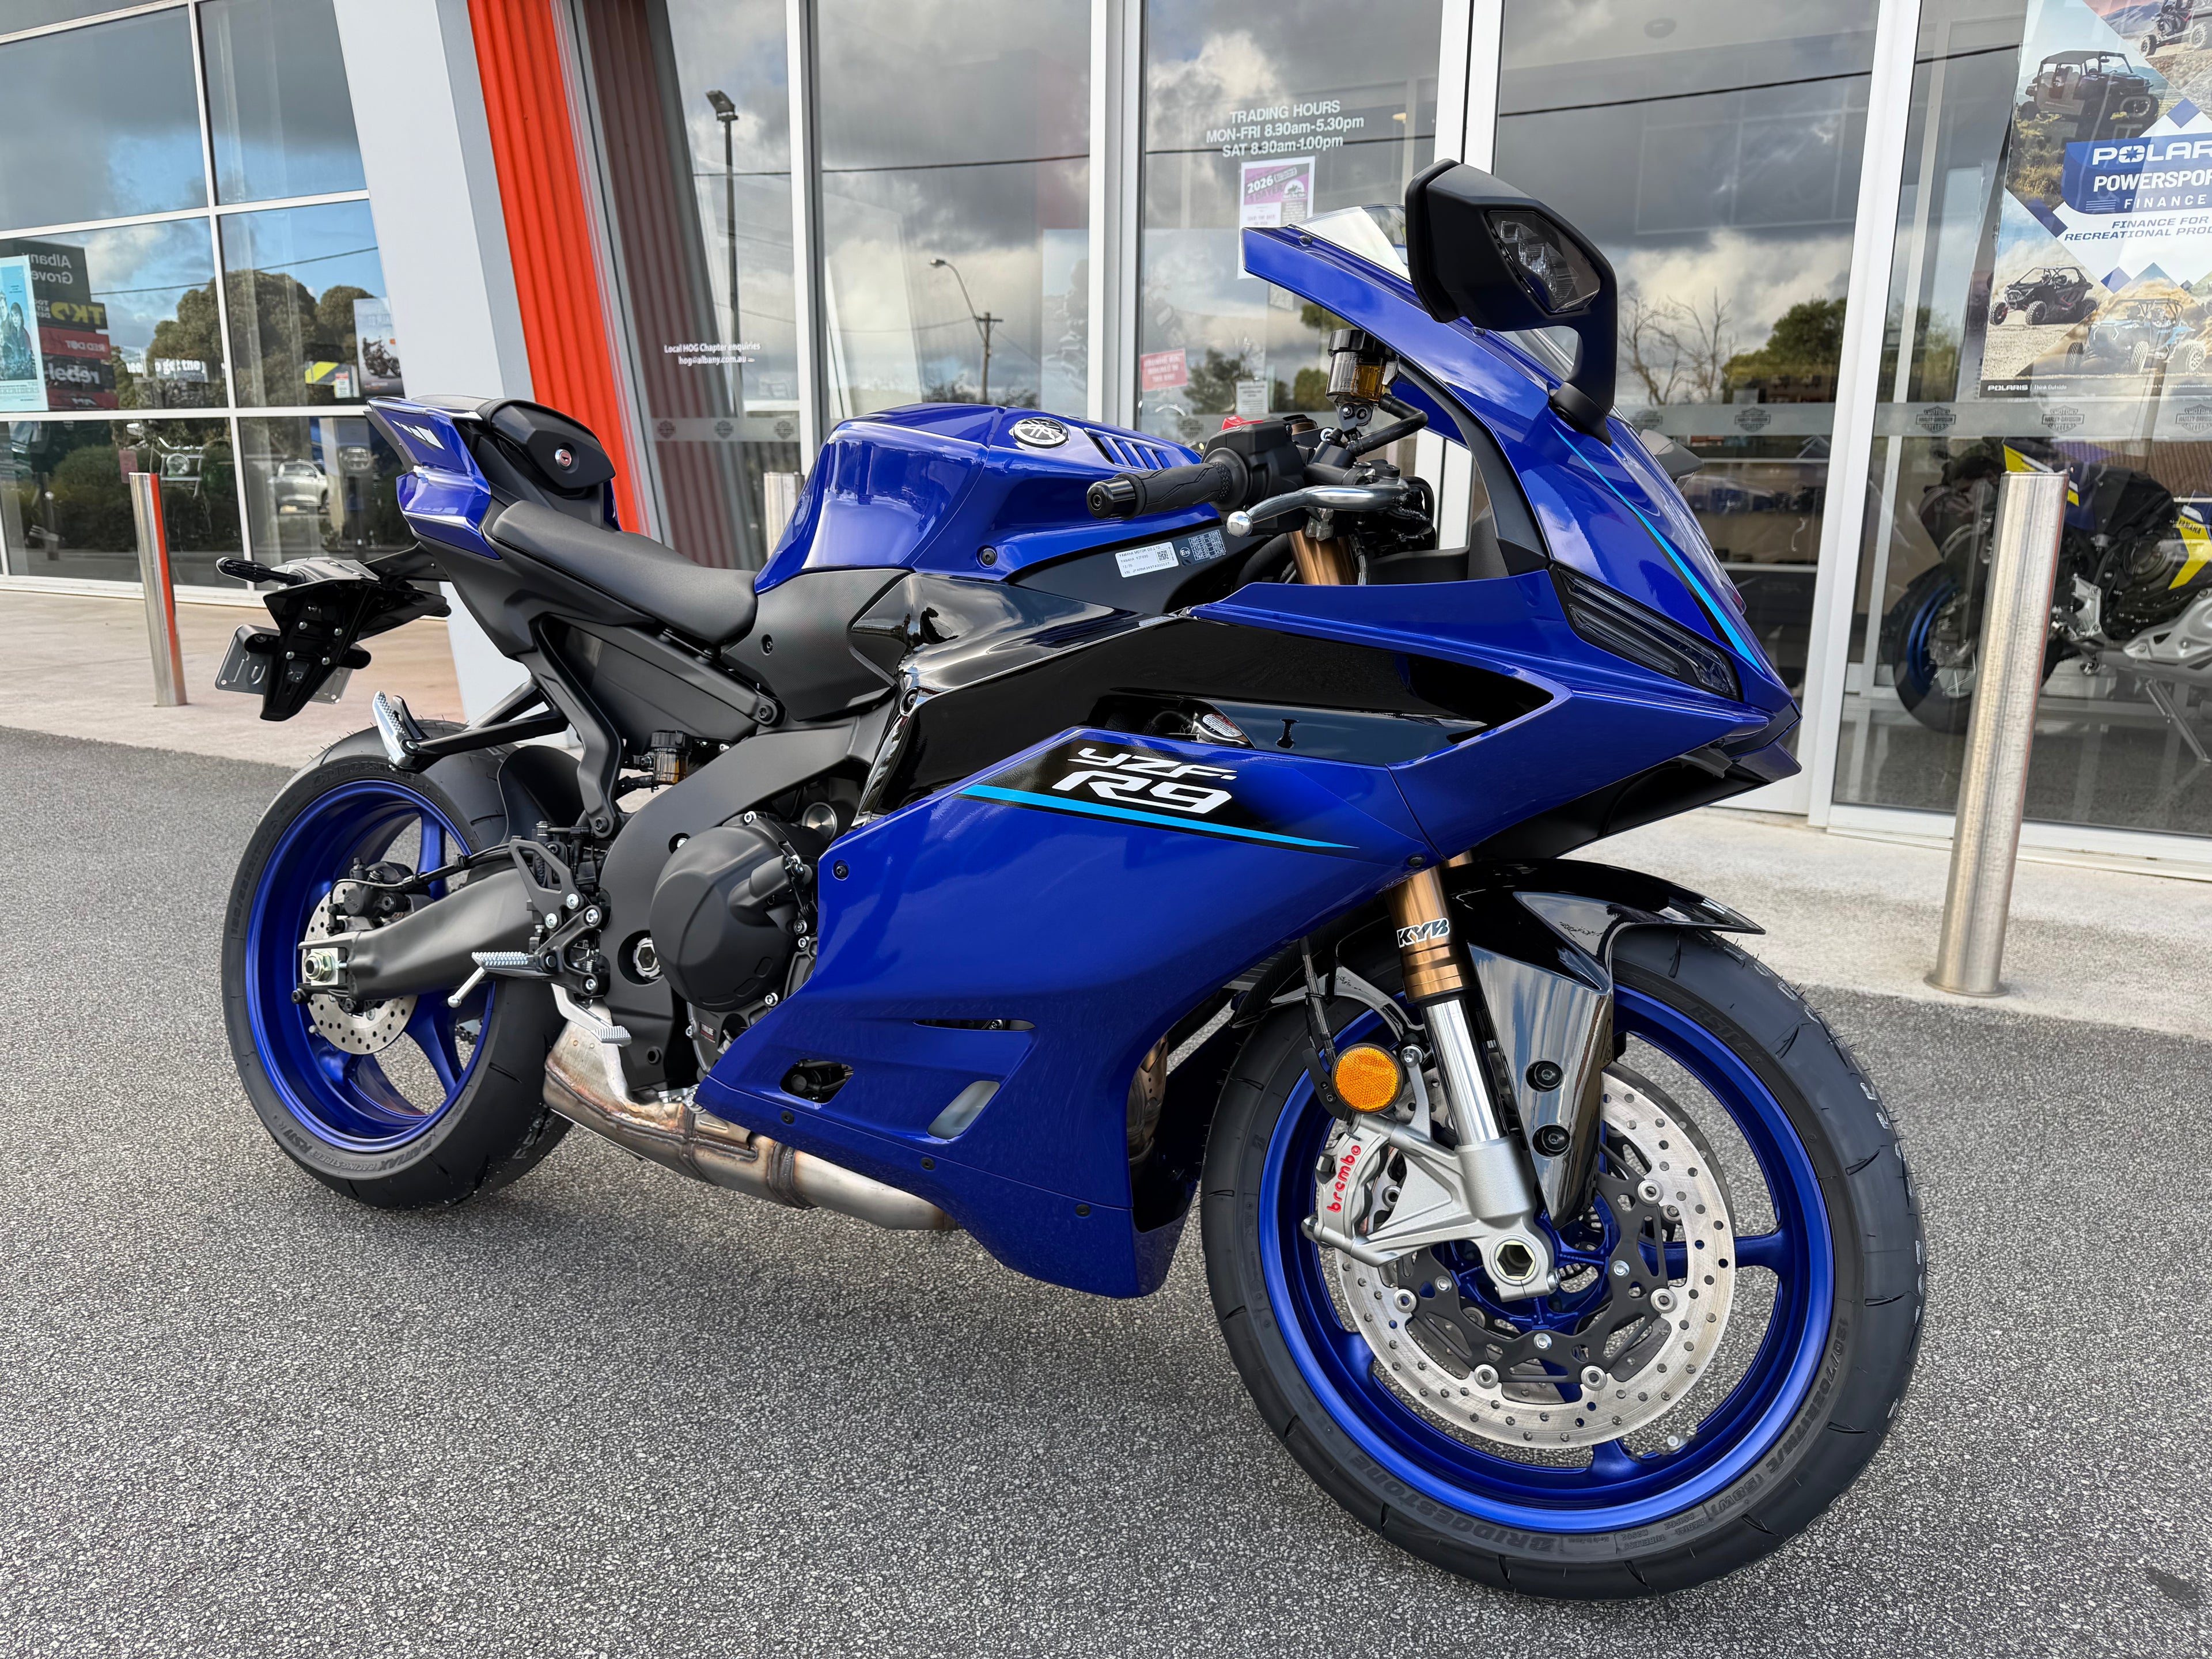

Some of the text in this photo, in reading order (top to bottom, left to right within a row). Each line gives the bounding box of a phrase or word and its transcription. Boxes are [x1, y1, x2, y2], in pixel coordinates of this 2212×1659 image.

[1229, 100, 1340, 124] TRADING HOURS
[1206, 116, 1364, 143] MON-FRI 8.30am-5.30pm
[1222, 136, 1344, 158] SAT 8.30am-1.00pm
[1247, 175, 1274, 194] 2026
[2124, 194, 2207, 209] FINANCE
[2111, 216, 2209, 229] FINANCE FOR
[2064, 229, 2172, 241] RECREATIONAL
[664, 344, 682, 353] Local
[683, 343, 699, 353] HOG
[699, 343, 729, 354] Chapter
[1987, 384, 2029, 392] POLARIS
[2179, 517, 2202, 536] YAMAHA
[1051, 770, 1232, 814] R9
[1396, 918, 1450, 948] KYB
[1326, 1145, 1361, 1213] brembo
[1349, 1454, 1556, 1552] BRIDGESTONE
[1623, 1533, 1666, 1550] TUBELESS
